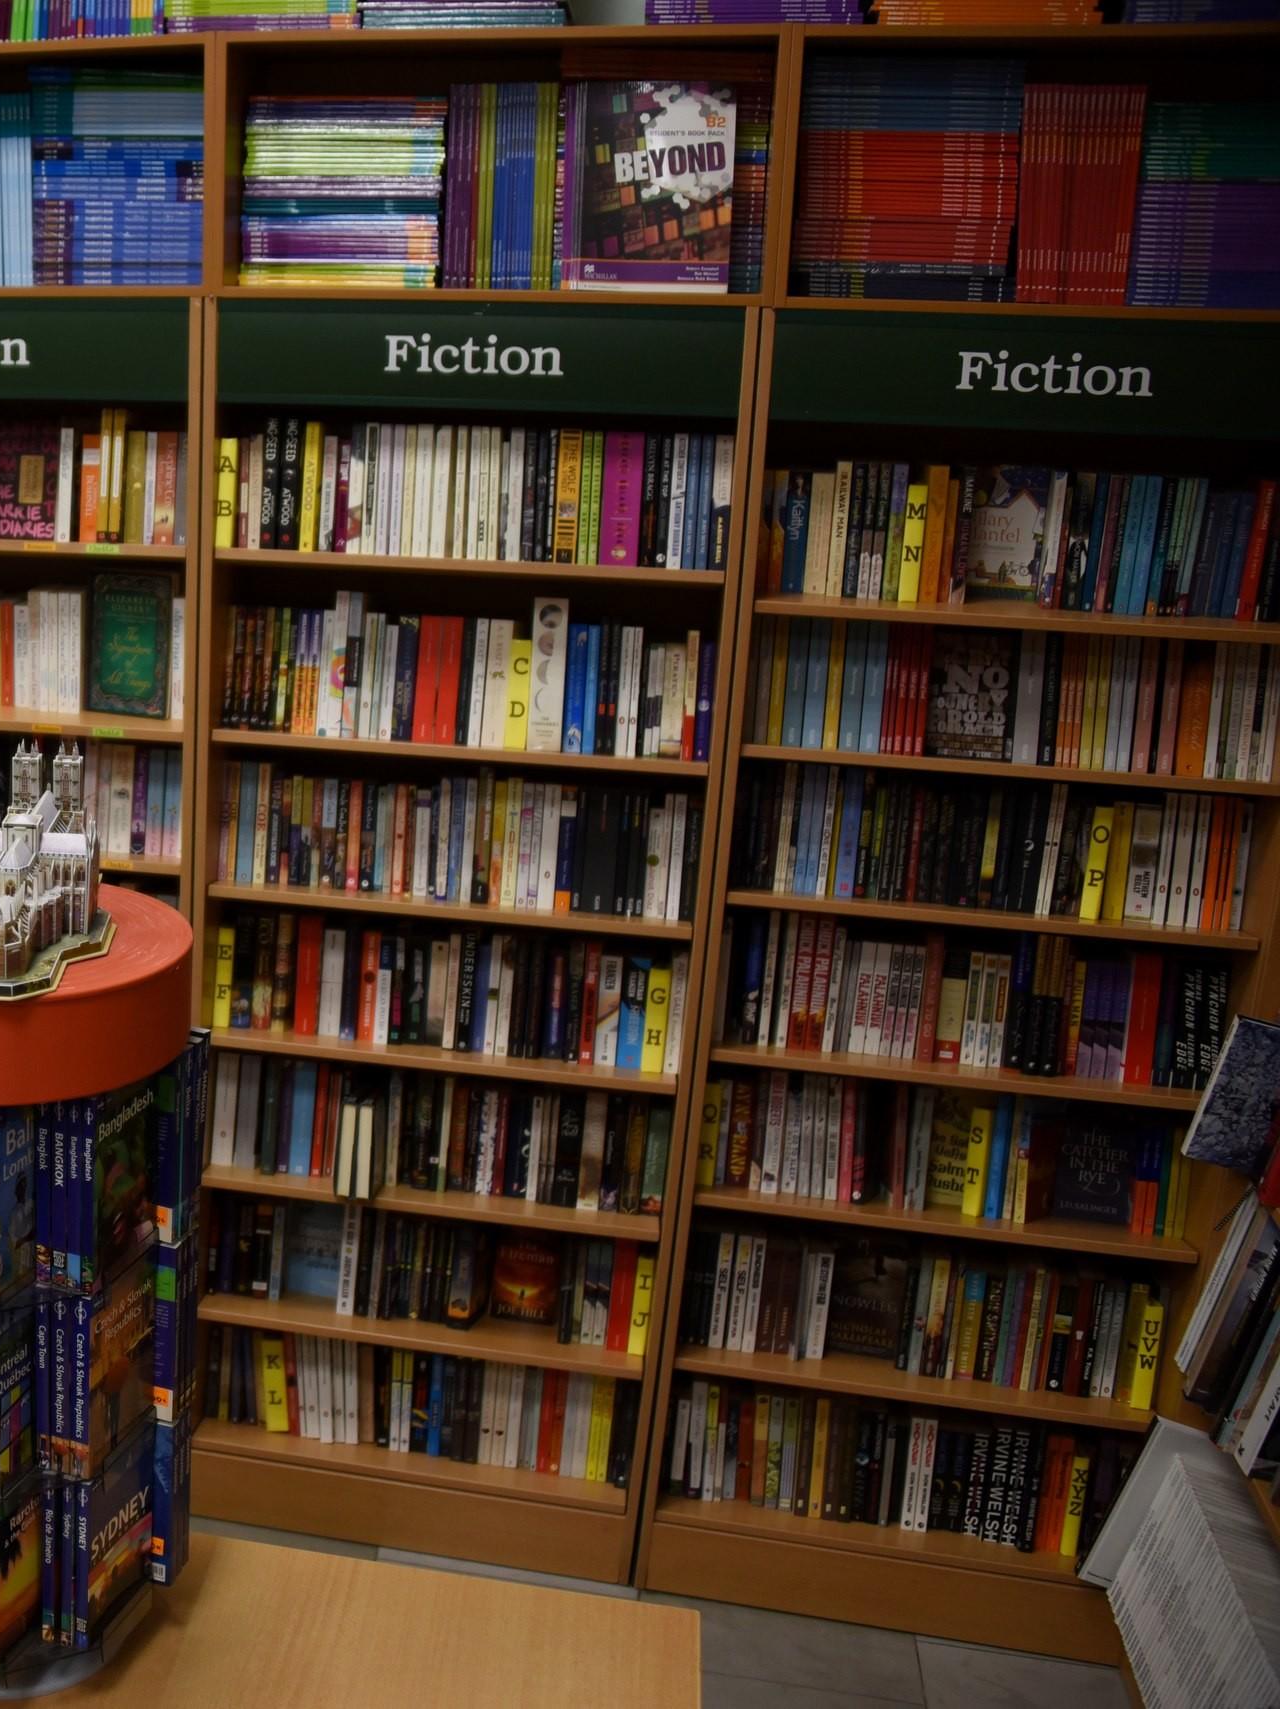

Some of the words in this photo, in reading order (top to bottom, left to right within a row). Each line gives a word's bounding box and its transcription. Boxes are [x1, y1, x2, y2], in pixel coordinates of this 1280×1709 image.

[614, 142, 726, 183] BEYOND
[384, 333, 564, 378] Fiction
[955, 350, 1153, 398] Fiction
[266, 418, 278, 461] HAG-SEED
[285, 419, 298, 462] HAG-SEED
[218, 456, 235, 473] A
[567, 465, 576, 493] WOLF
[217, 500, 233, 517] B
[262, 487, 272, 525] ATWOOD
[280, 488, 292, 526] ATWOOD
[788, 500, 806, 540] Kaitlyn
[908, 503, 926, 520] M
[0, 520, 56, 538] DIARIES
[835, 517, 846, 538] MAN
[904, 546, 922, 561] N
[514, 658, 528, 674] C
[942, 663, 1010, 694] NO
[510, 701, 525, 717] D
[1093, 825, 1110, 844] O
[1089, 869, 1105, 887] P
[218, 946, 232, 959] E
[463, 933, 476, 972] UNDER
[604, 961, 617, 989] FRANZEN
[791, 956, 811, 1013] PALAHNIUK
[810, 958, 829, 1015] PALAHNIUK
[217, 985, 231, 999] F
[461, 980, 473, 1007] SKIN
[651, 988, 666, 1004] G
[854, 973, 871, 1026] PALAHNIUK
[869, 974, 886, 1028] PALAHNIUK
[1071, 979, 1084, 1026] PULLMAN
[1185, 974, 1196, 1028] PYNCHON
[1209, 976, 1219, 1031] PYNCHON
[647, 1030, 662, 1045] H
[1176, 1041, 1187, 1071] EDGE
[1200, 1044, 1211, 1072] EDGE
[98, 1088, 154, 1142] Bangladesh
[703, 1104, 717, 1123] Q
[38, 1128, 48, 1170] Bangkok
[971, 1127, 983, 1144] S
[1082, 1128, 1112, 1146] THE
[54, 1132, 64, 1188] BANGKOK
[70, 1136, 78, 1180] Bangladesh
[85, 1138, 93, 1182] Bangladesh
[699, 1144, 713, 1159] R
[728, 1133, 748, 1175] RAND
[1062, 1144, 1129, 1162] CATCHER
[1070, 1156, 1087, 1170] IN
[1092, 1159, 1120, 1175] THE
[966, 1167, 979, 1185] T
[1078, 1170, 1108, 1190] RYE
[640, 1274, 652, 1290] I
[718, 1268, 728, 1291] SELF
[736, 1271, 746, 1294] SELF
[633, 1312, 649, 1327] J
[37, 1325, 47, 1347] Cape
[55, 1328, 65, 1351] Czech
[76, 1333, 85, 1361] Czech
[1140, 1320, 1160, 1370] UVW
[38, 1348, 48, 1369] Town
[56, 1353, 64, 1361] &
[267, 1355, 280, 1370] K
[56, 1362, 65, 1395] Slovak
[76, 1370, 84, 1396] Slovak
[268, 1391, 281, 1405] L
[55, 1397, 65, 1433] Republics
[75, 1397, 84, 1439] Republics
[992, 1428, 1012, 1483] IRVINE
[1009, 1431, 1031, 1487] IRVINE
[1069, 1468, 1088, 1516] XYZ
[44, 1509, 53, 1525] Rio
[91, 1485, 150, 1562] SYDNEY
[964, 1487, 983, 1536] WELSH
[984, 1487, 1004, 1543] WELSH
[1001, 1490, 1023, 1546] WELSH
[62, 1513, 71, 1539] Sydney
[78, 1516, 87, 1551] SYDNEY
[44, 1536, 53, 1565] Janeiro
